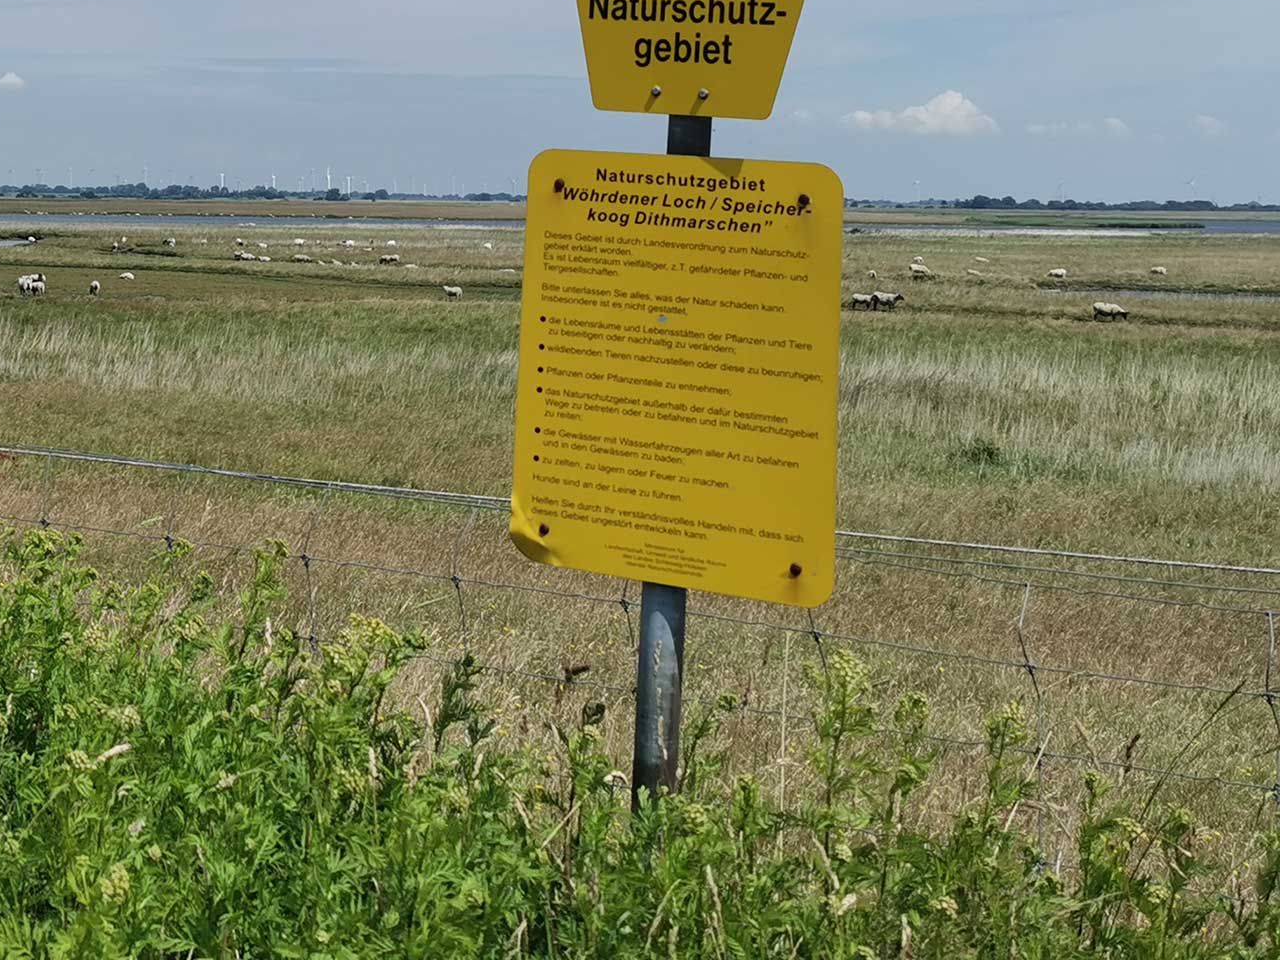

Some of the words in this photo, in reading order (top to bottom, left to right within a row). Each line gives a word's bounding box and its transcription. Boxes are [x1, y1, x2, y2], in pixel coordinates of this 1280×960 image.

[634, 32, 732, 67] gebiet
[596, 168, 765, 192] Naturschutzgebiet
[587, 207, 630, 227] koog
[662, 193, 706, 209] Loch
[710, 196, 718, 210] /
[721, 197, 811, 216] Speicher-
[543, 241, 569, 250] gebiet
[571, 243, 597, 252] erklärt
[544, 230, 572, 240] Dieses
[575, 233, 603, 242] Gebiet
[605, 235, 614, 243] ist
[616, 236, 641, 245] durch
[643, 238, 726, 254] Landesverordnung
[543, 252, 553, 260] Es
[556, 253, 566, 261] ist
[568, 254, 620, 266] Lebensraum
[689, 264, 741, 276] gefährdeter
[743, 268, 786, 279] Pflanzen-
[790, 273, 808, 281] und
[541, 283, 560, 292] Bitte
[562, 285, 611, 297] unterlassen
[613, 289, 627, 298] Sie
[675, 294, 689, 304] der
[693, 296, 716, 306] Natur
[719, 299, 759, 310] schaden
[541, 293, 597, 306] Insbesondere
[599, 298, 609, 307] ist
[624, 301, 645, 310] nicht
[548, 316, 561, 325] die
[563, 317, 621, 331] Lebensräume
[624, 324, 639, 333] und
[642, 325, 705, 339] Lebensstätten
[707, 331, 722, 341] der
[725, 333, 765, 345] Pflanzen
[768, 339, 785, 347] und
[789, 340, 812, 350] Tiere
[561, 327, 603, 340] beseitigen
[606, 333, 625, 342] oder
[628, 336, 672, 349] nachhaltig
[547, 344, 602, 357] wildlebenden
[605, 349, 631, 360] Tieren
[633, 354, 694, 367] nachzustellen
[697, 360, 716, 369] oder
[720, 362, 744, 372] diese
[748, 366, 758, 374] zu
[546, 366, 582, 378] Pflanzen
[585, 371, 604, 380] oder
[606, 373, 663, 387] Pflanzenteile
[544, 397, 568, 409] Wege
[571, 402, 581, 410] zu
[584, 402, 619, 414] betreten
[621, 407, 641, 417] oder
[644, 411, 654, 419] zu
[657, 411, 696, 424] befahren
[699, 417, 716, 426] und
[719, 418, 730, 428] im
[733, 420, 819, 439] Naturschutzgebiet
[545, 386, 560, 396] das
[563, 388, 640, 406] Naturschutzgebiet
[642, 399, 687, 411] außerhalb
[690, 403, 704, 413] der
[707, 406, 731, 416] dafür
[733, 409, 787, 423] bestimmten
[543, 426, 555, 436] die
[558, 428, 601, 442] Gewässer
[603, 435, 617, 444] mit
[619, 436, 702, 456] Wasserfahrzeugen
[705, 448, 724, 458] aller
[727, 450, 740, 460] Art
[743, 454, 754, 462] zu
[756, 454, 799, 468] befahren
[543, 439, 558, 448] und
[561, 440, 568, 449] in
[570, 441, 587, 451] den
[590, 444, 639, 458] Gewässern
[641, 452, 651, 460] zu
[542, 456, 552, 464] zu
[584, 462, 594, 470] zu
[598, 462, 624, 474] lagern
[627, 467, 646, 477] oder
[650, 469, 675, 481] Feuer
[678, 475, 689, 483] zu
[532, 472, 560, 484] Hunde
[563, 477, 580, 487] sind
[582, 481, 593, 489] an
[595, 481, 610, 491] der
[612, 483, 636, 495] Leine
[639, 489, 649, 497] zu
[531, 494, 559, 506] Helfen
[561, 499, 575, 509] Sie
[577, 501, 601, 512] durch
[604, 505, 615, 514] Ihr
[618, 509, 694, 526] verständnisvolles
[698, 518, 736, 532] Handeln
[758, 527, 780, 539] dass
[785, 532, 803, 542] sich
[531, 505, 558, 517] dieses
[560, 510, 588, 522] Gebiet
[591, 516, 631, 528] ungestört
[634, 522, 681, 536] entwickeln
